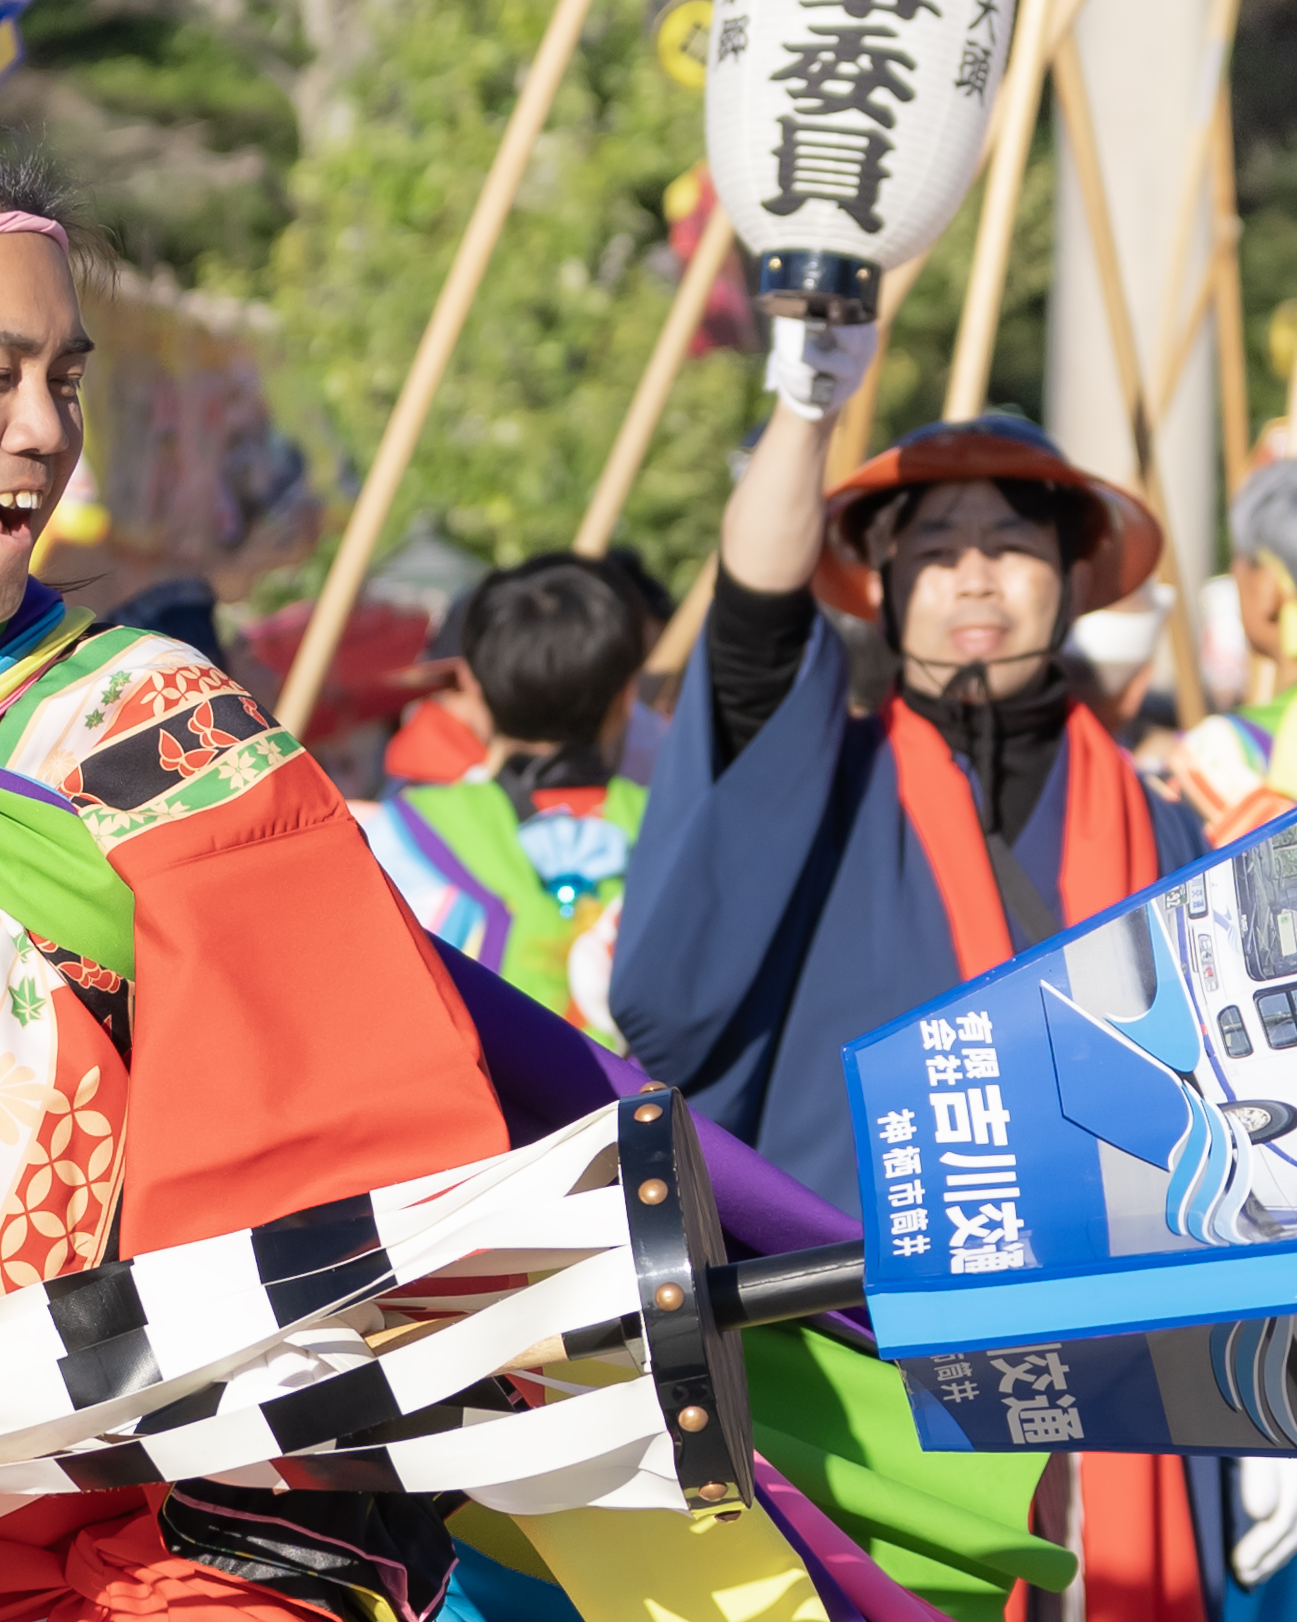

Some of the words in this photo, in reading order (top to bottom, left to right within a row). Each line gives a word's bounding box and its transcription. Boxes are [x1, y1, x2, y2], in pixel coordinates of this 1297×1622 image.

[919, 1017, 964, 1087] 会社
[955, 1010, 1001, 1079] 有限
[877, 1108, 932, 1257] 神栖市筒井
[929, 1084, 1025, 1275] 吉川交通
